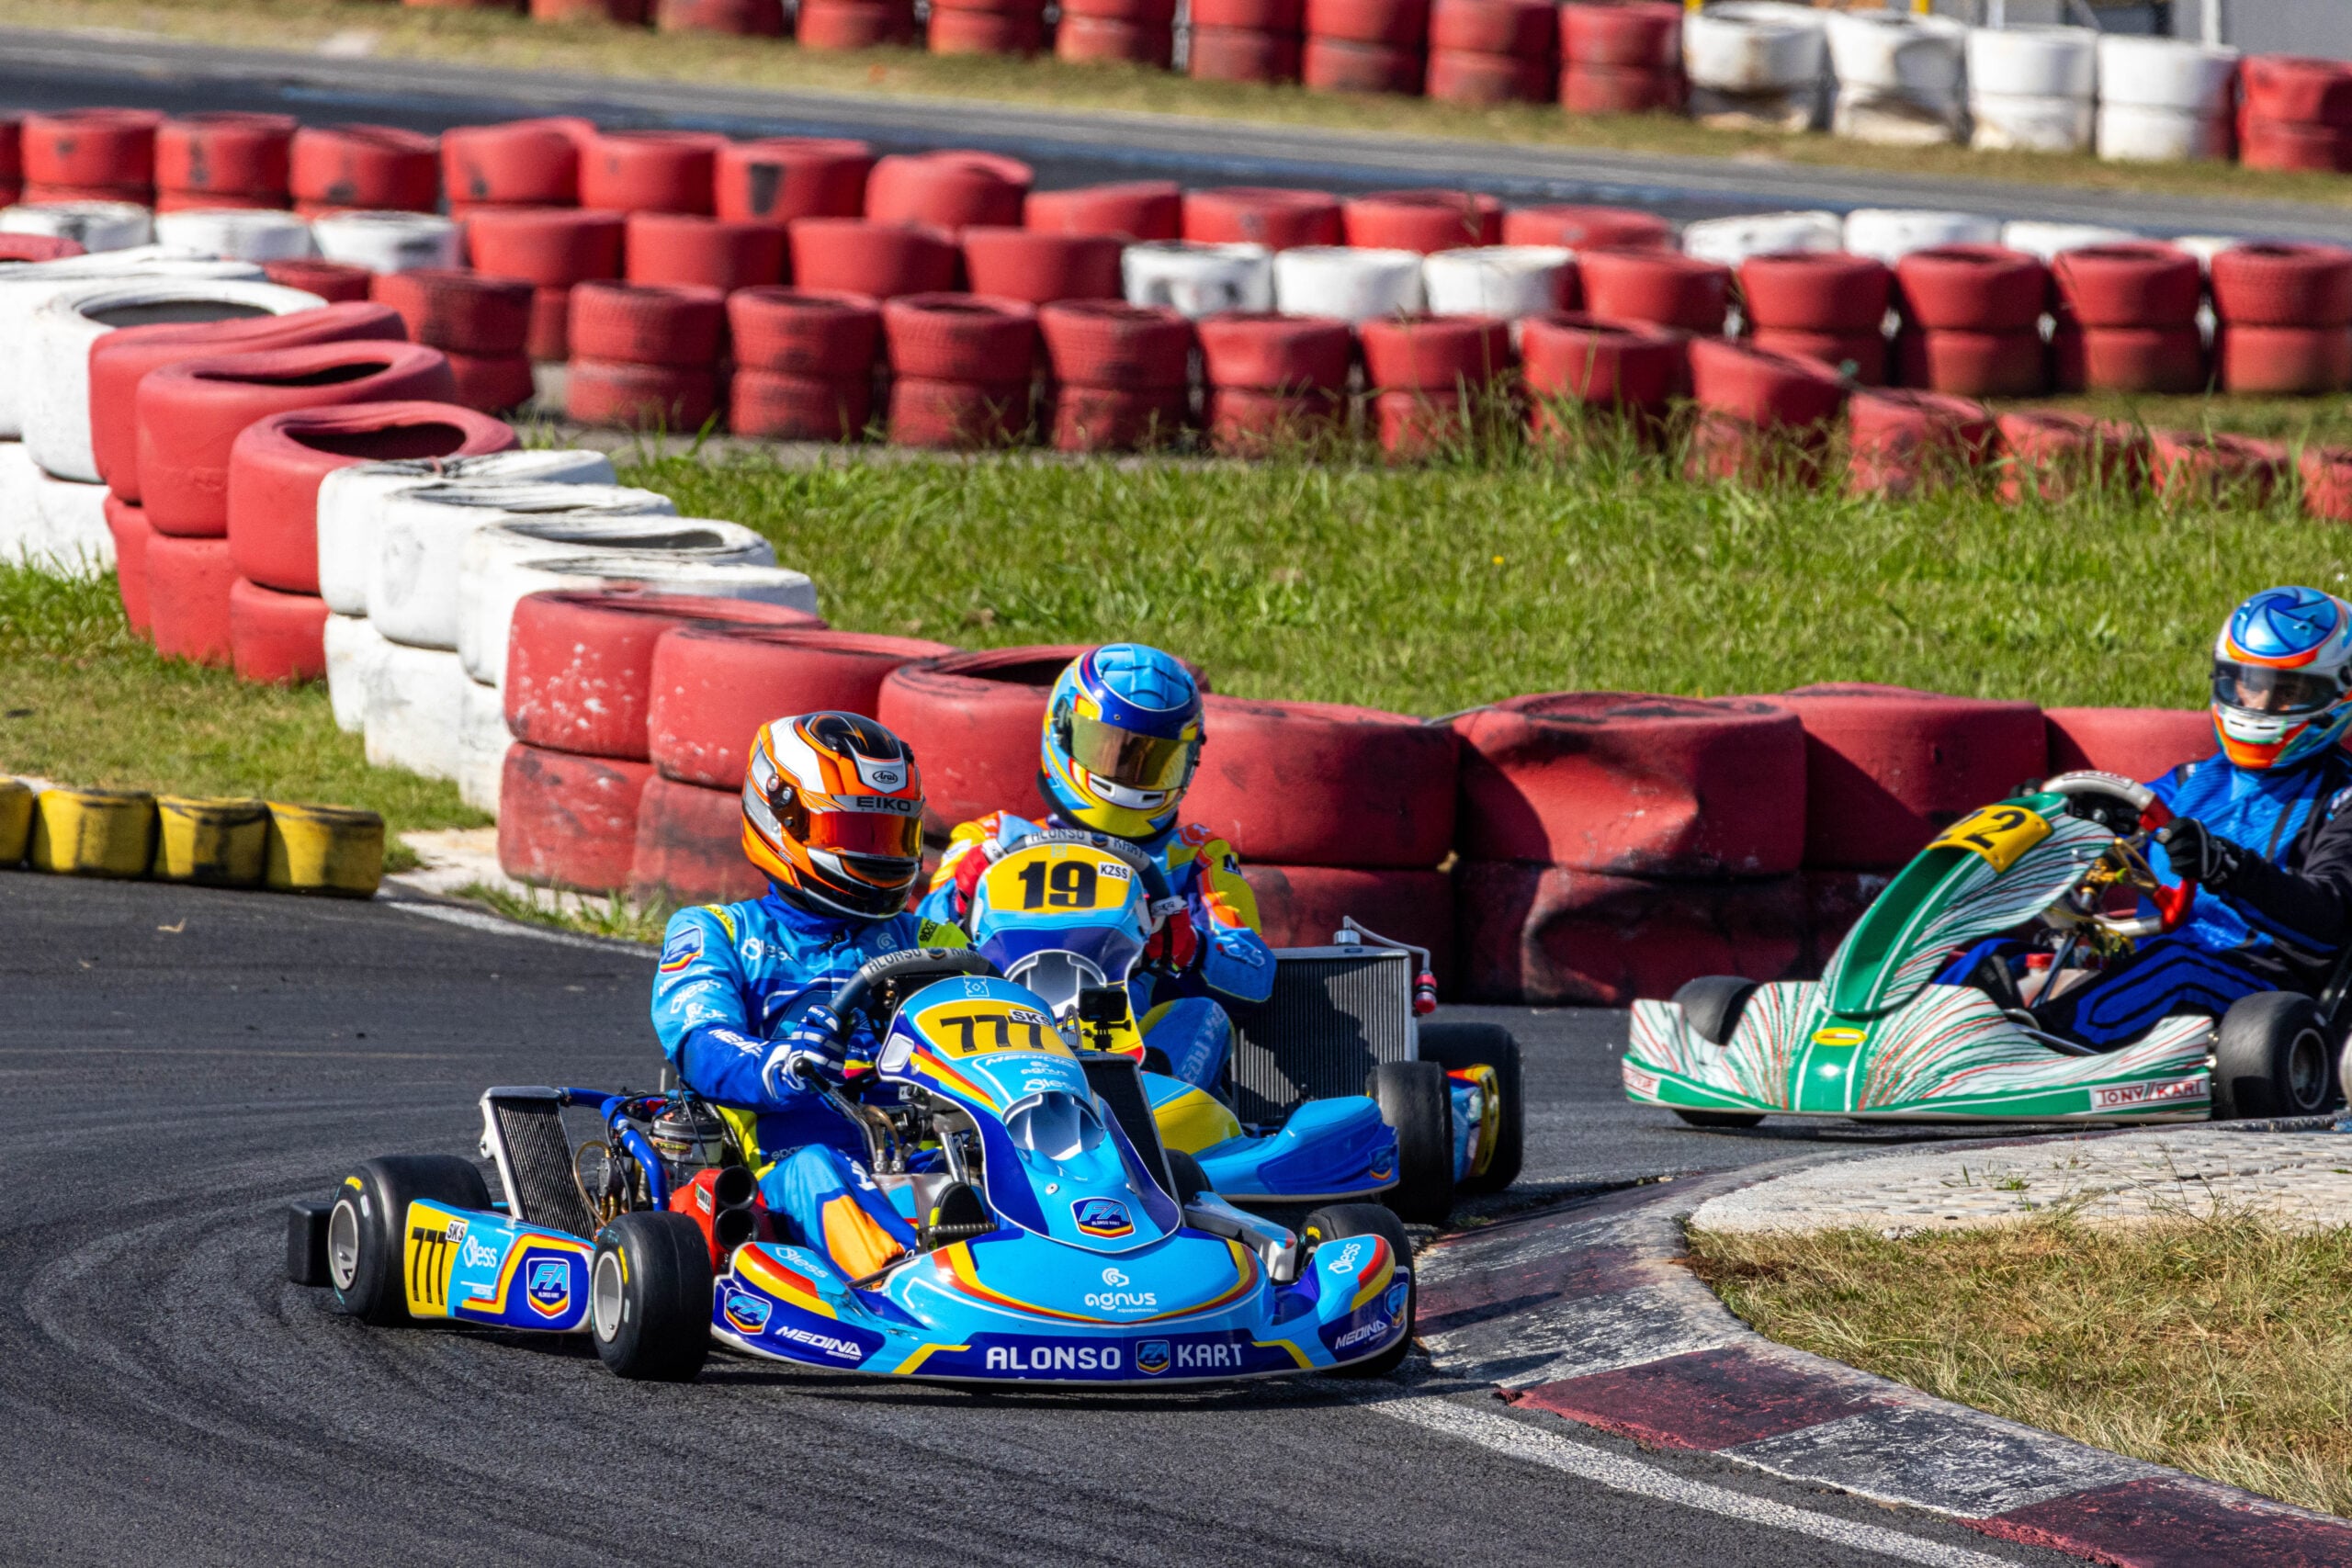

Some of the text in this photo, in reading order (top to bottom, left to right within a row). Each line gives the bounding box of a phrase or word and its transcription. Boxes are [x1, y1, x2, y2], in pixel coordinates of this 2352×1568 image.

[856, 795, 911, 812] EIKO
[1100, 863, 1129, 879] KZSS
[1018, 861, 1098, 909] 19
[1012, 1010, 1051, 1026] SKS
[939, 1014, 1046, 1053] 777
[2155, 1078, 2206, 1100] KART
[1079, 1201, 1130, 1223] FA
[447, 1223, 465, 1241] SKS
[411, 1226, 448, 1305] 777
[529, 1263, 568, 1292] FA
[726, 1295, 770, 1322] FA
[1084, 1292, 1158, 1311] agnus
[775, 1325, 863, 1357] MEDINA
[1334, 1319, 1388, 1350] MEDINA
[986, 1344, 1242, 1371] ALONSO KART
